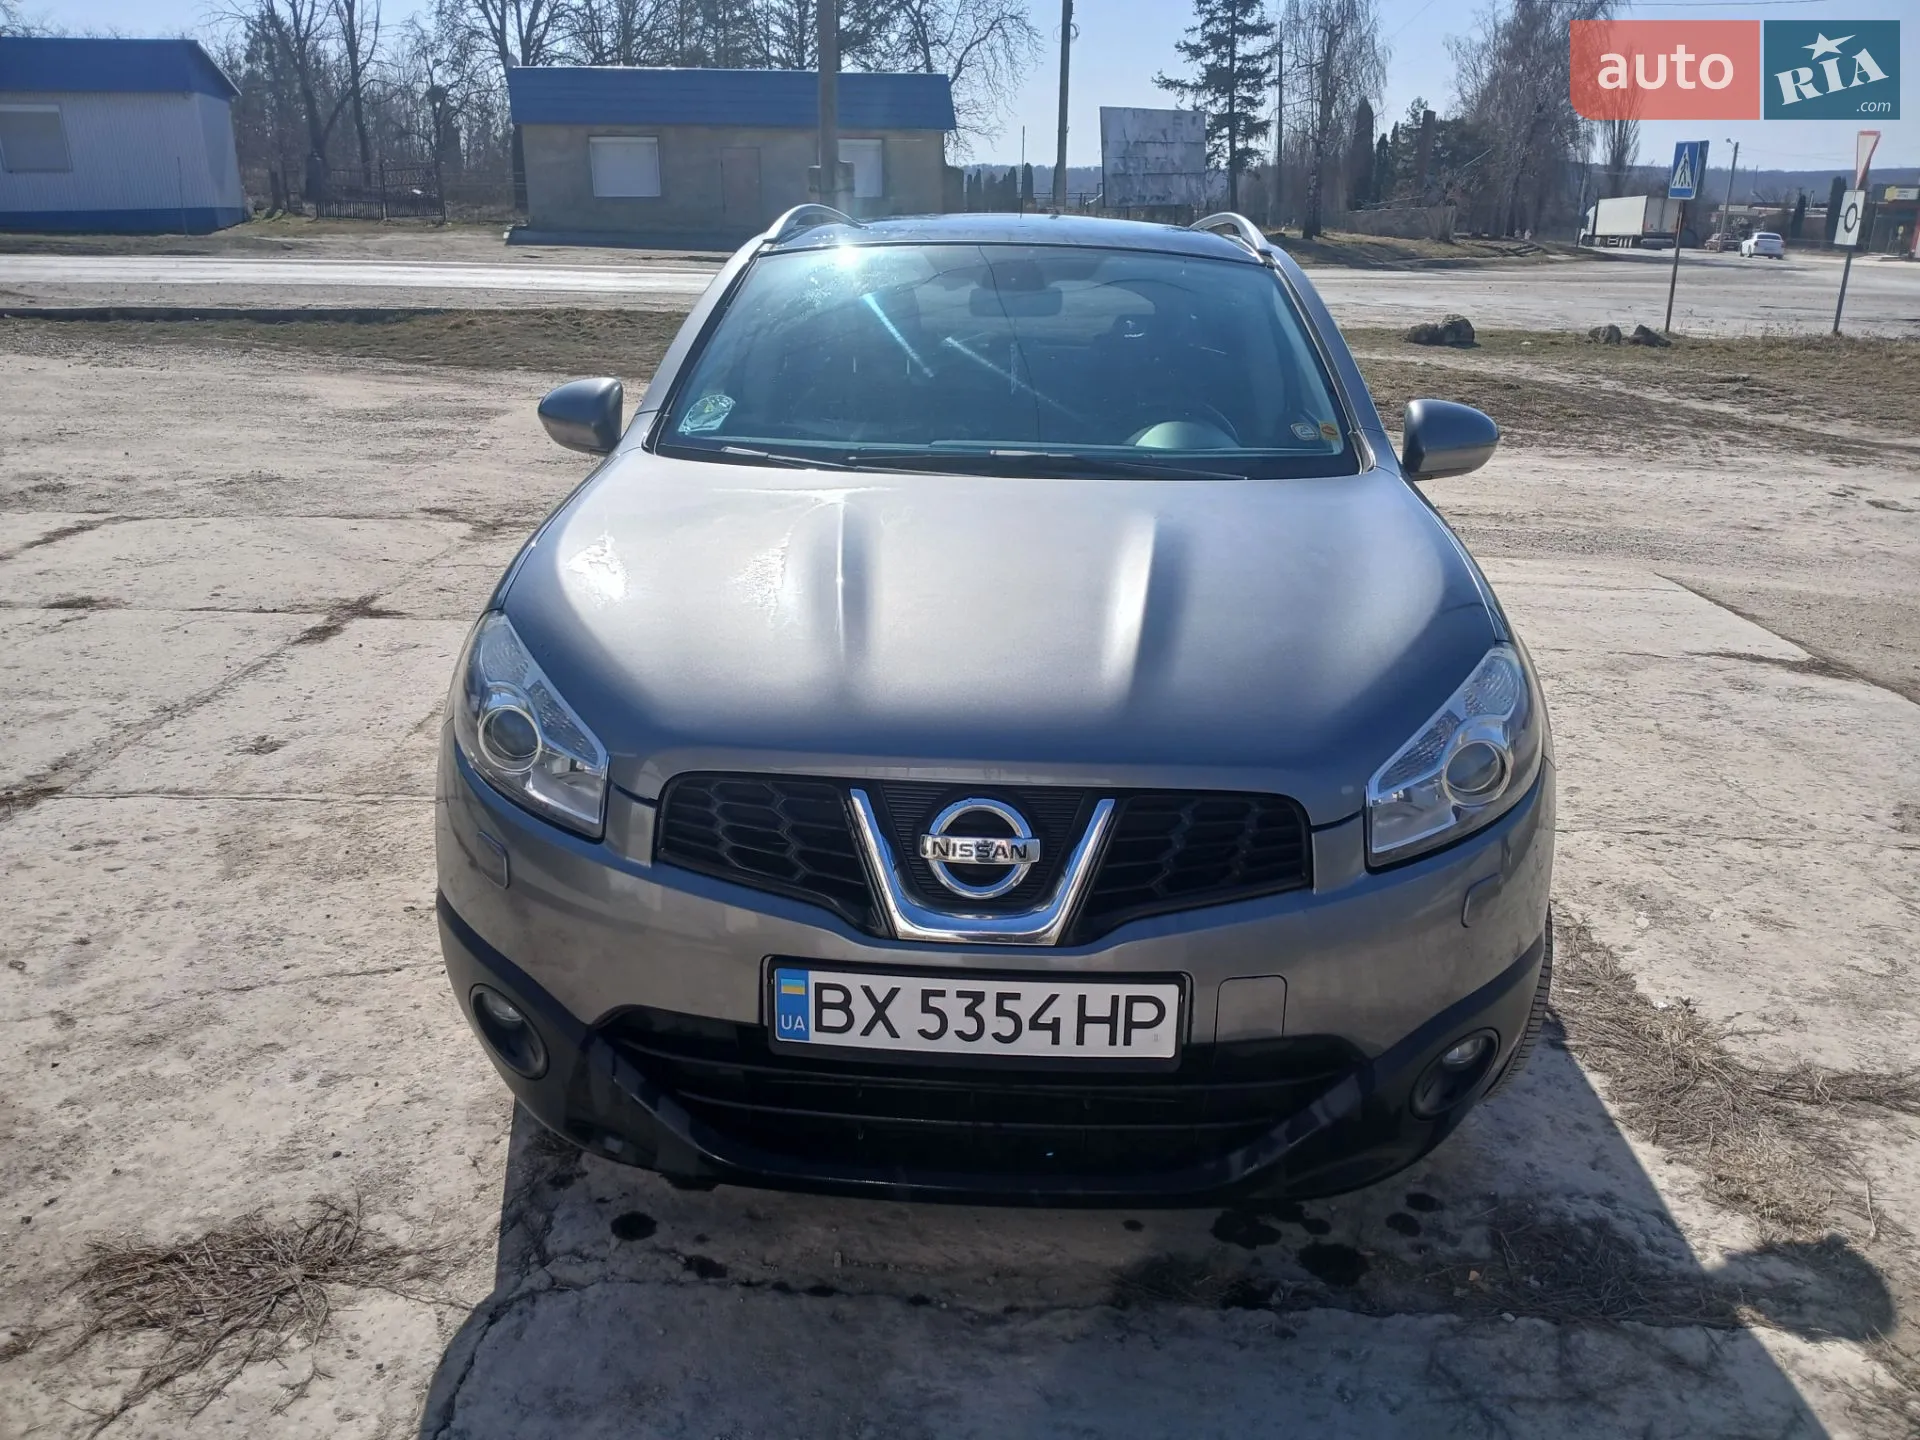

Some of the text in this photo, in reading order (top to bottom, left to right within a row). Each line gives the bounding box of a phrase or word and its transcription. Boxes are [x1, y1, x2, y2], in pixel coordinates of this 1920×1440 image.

[932, 840, 1028, 859] NISSAN
[781, 1014, 806, 1032] UA
[814, 981, 1166, 1046] BX 5354 HP
